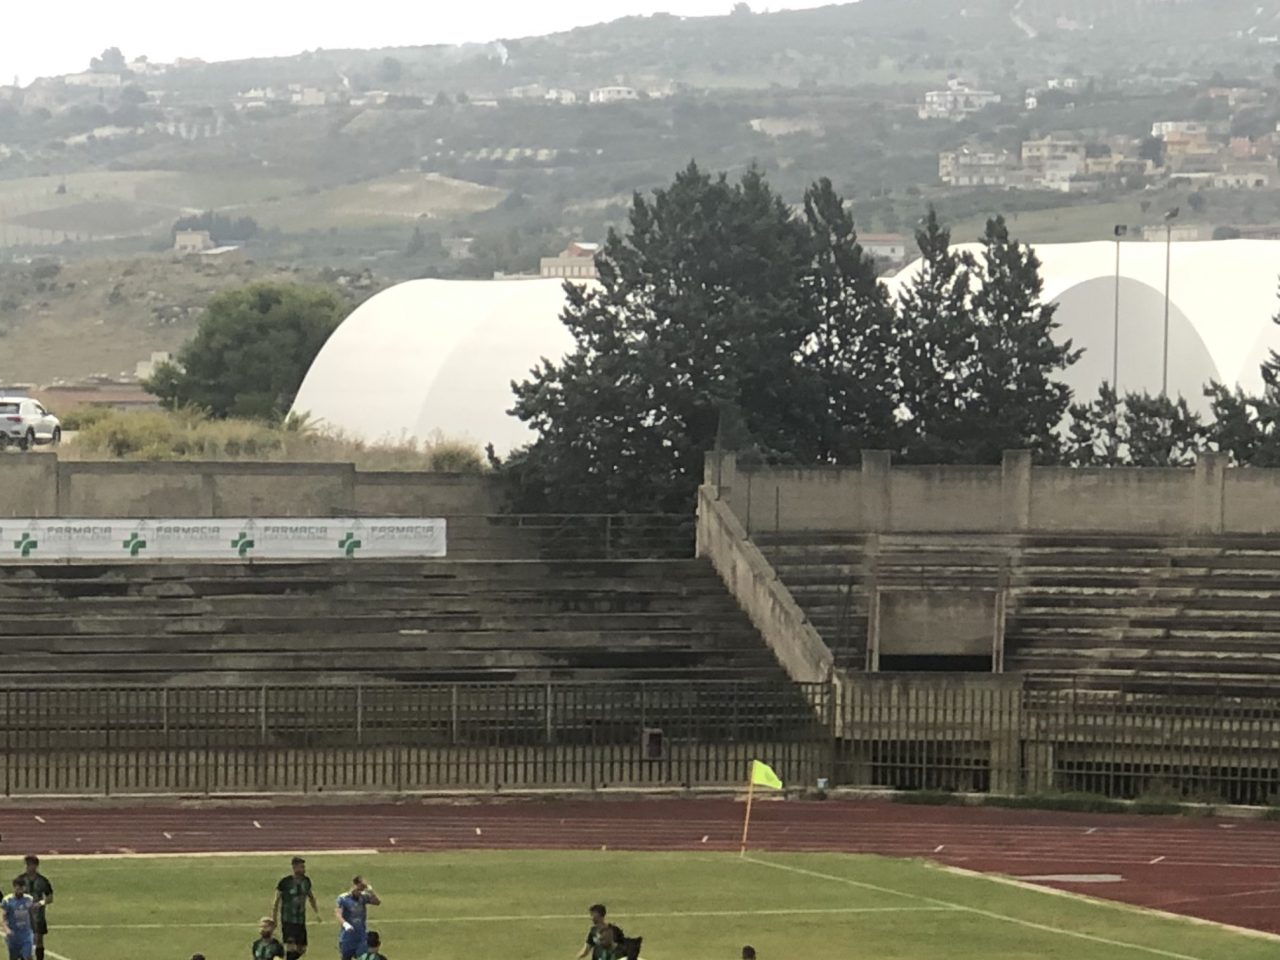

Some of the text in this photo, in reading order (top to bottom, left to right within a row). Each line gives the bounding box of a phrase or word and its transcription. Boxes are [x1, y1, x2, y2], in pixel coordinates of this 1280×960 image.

[47, 526, 112, 535] FARMACIA
[156, 526, 220, 535] FARMACIA
[264, 526, 328, 535] FARMACIA
[371, 525, 434, 534] FARMACIA
